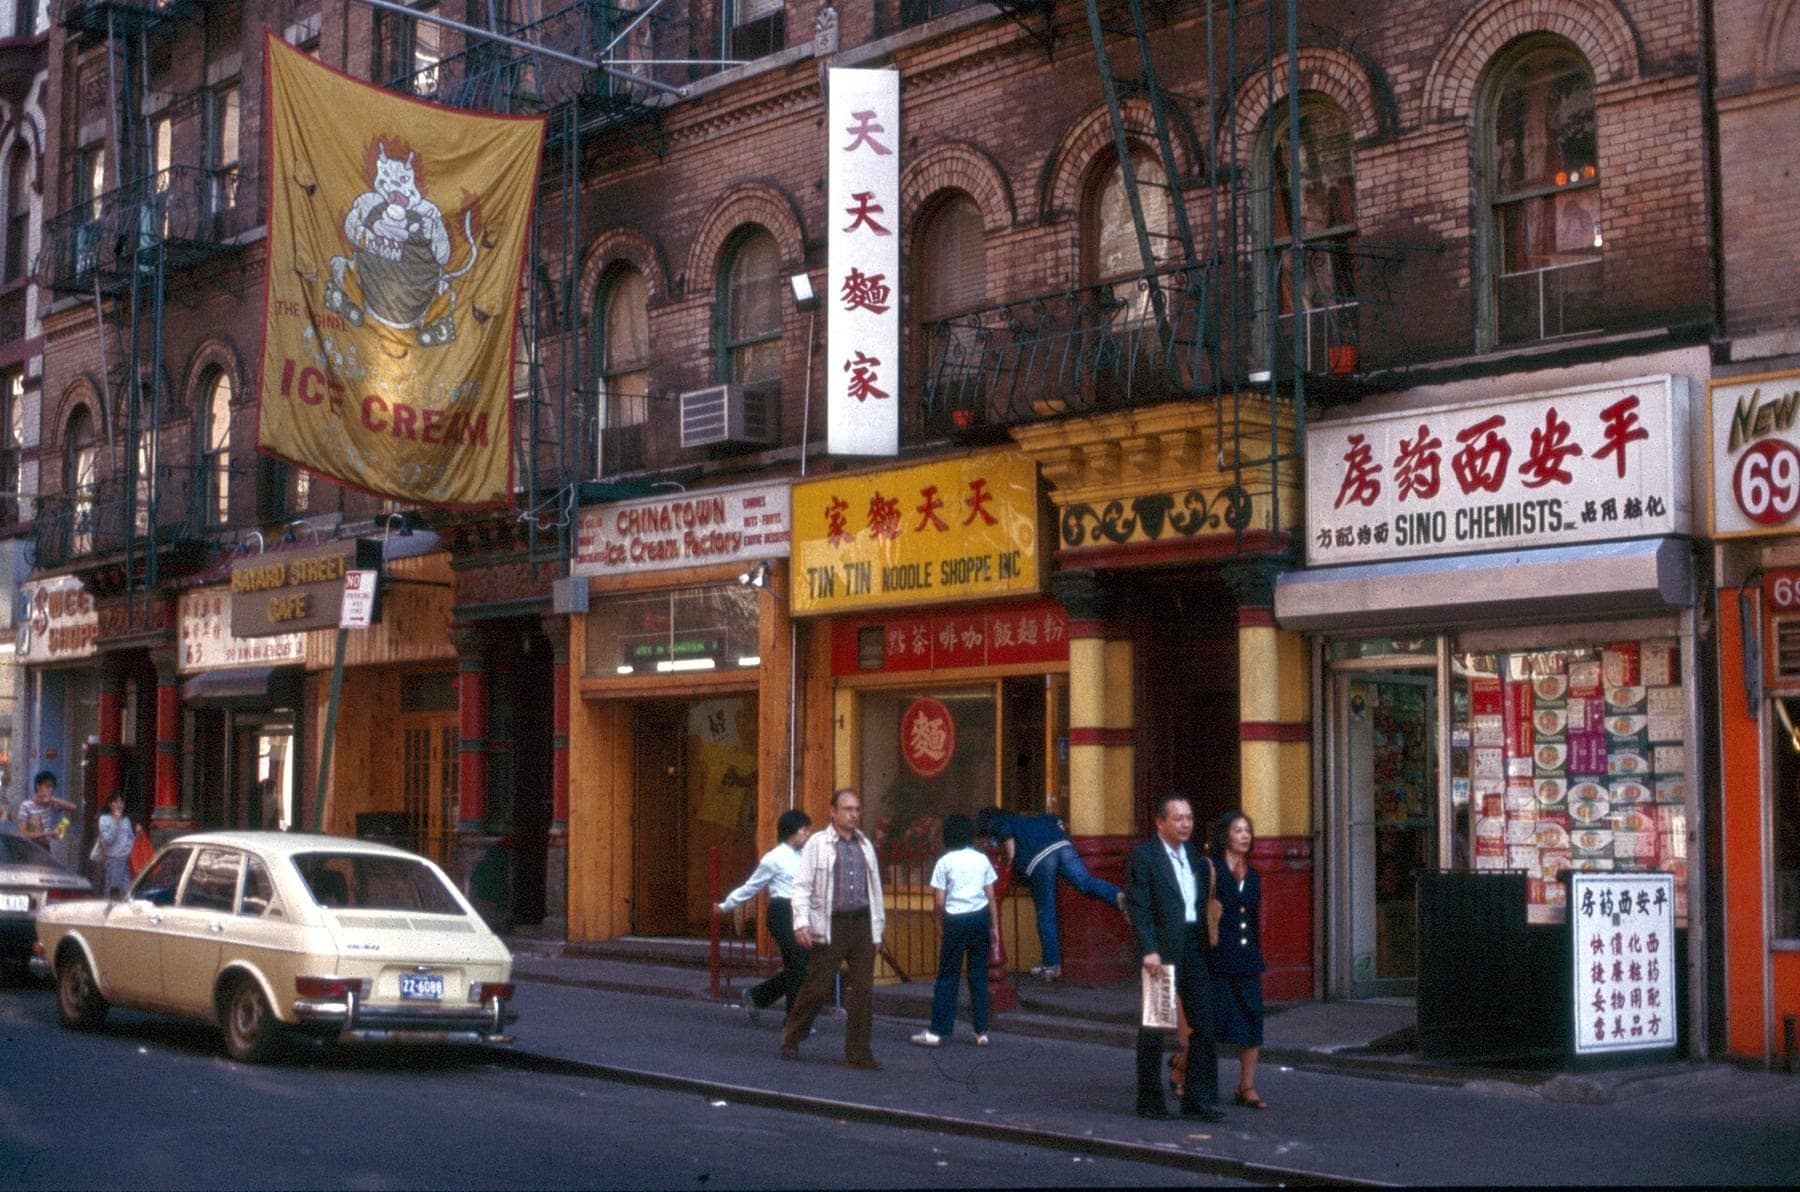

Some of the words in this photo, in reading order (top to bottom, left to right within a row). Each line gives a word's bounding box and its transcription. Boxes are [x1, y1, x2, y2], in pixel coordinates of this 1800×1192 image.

[840, 110, 893, 402] 天天麵家
[275, 300, 300, 317] THE
[280, 358, 346, 418] ICE
[360, 395, 489, 448] CREAM
[1741, 450, 1800, 514] 69
[616, 497, 727, 537] CHINATOWN
[1395, 510, 1447, 546] SINO
[1455, 499, 1562, 541] CHEMISTS
[604, 541, 627, 566] Ice
[630, 536, 680, 563] Cream
[683, 530, 743, 558] Factory
[231, 564, 286, 593] BAYARD
[289, 555, 346, 586] STREET
[346, 573, 361, 589] NO
[807, 565, 834, 600] TIN
[843, 561, 872, 595] TIN
[882, 562, 933, 592] NOODLE
[940, 554, 991, 586] SHOPPE
[999, 551, 1021, 580] INC
[267, 593, 307, 622] CAFE
